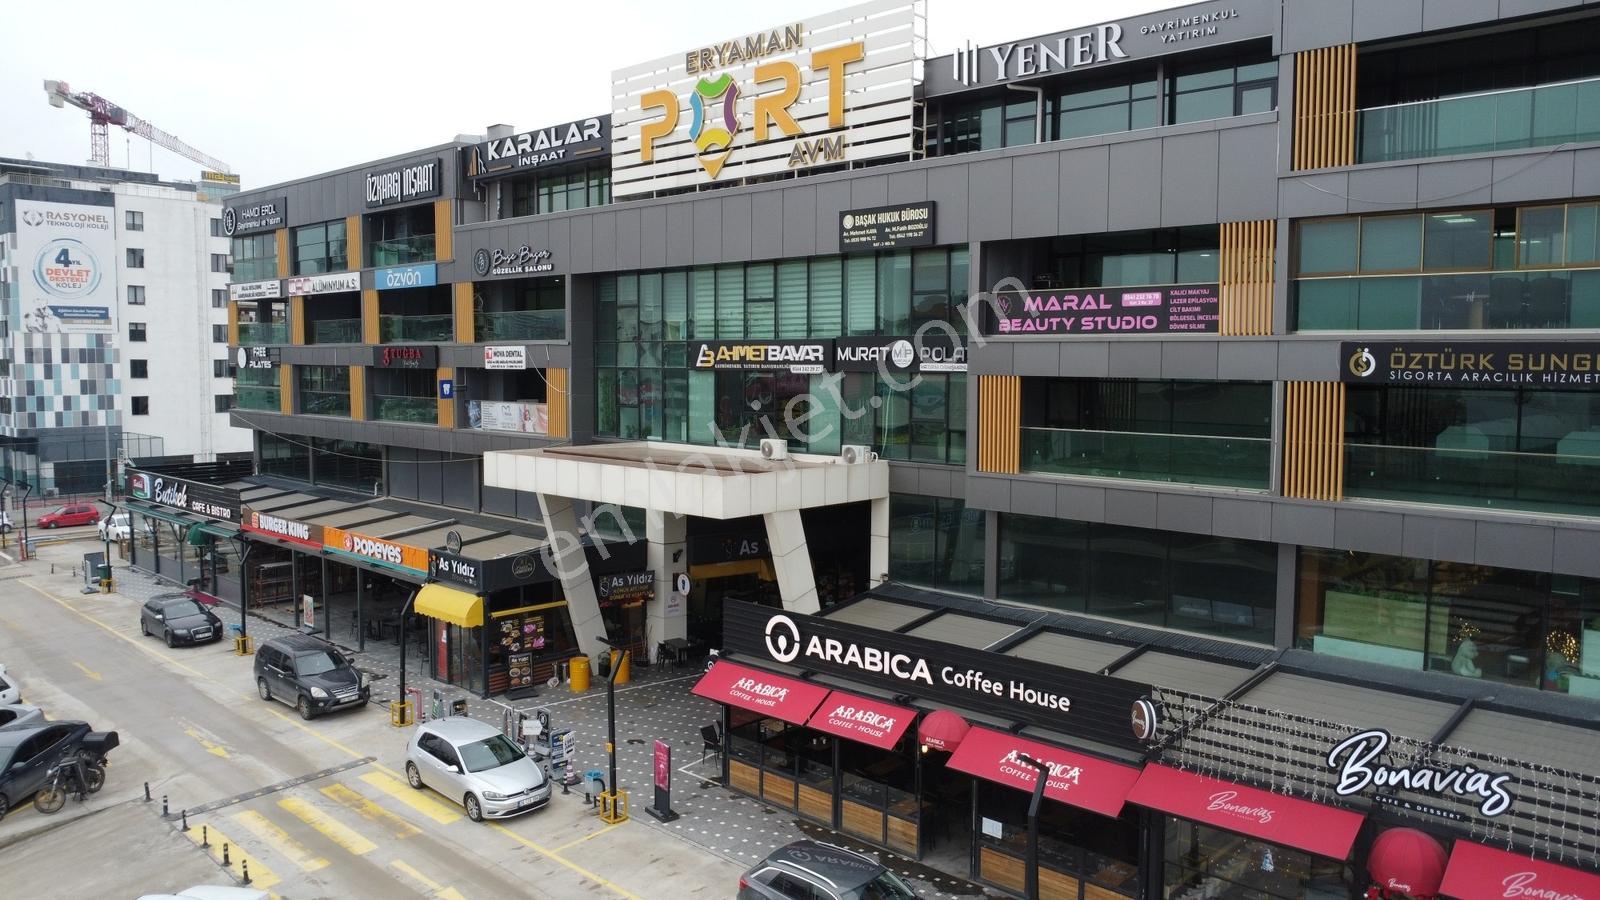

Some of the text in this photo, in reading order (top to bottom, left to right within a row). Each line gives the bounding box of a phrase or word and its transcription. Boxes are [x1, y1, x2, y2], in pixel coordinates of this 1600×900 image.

[1140, 8, 1239, 35] GAYRİMENKUL
[1160, 26, 1218, 44] YATIRIM
[685, 22, 803, 75] ERYAMAN
[988, 23, 1129, 81] YENER
[487, 117, 601, 161] KARALAR
[518, 149, 566, 168] İNŞAAT
[788, 133, 846, 168] AVM
[46, 211, 109, 224] RASYONEL
[46, 220, 109, 231] TEKNOLOJİ KOLEJİ
[855, 207, 928, 227] BAŞAK HUKUK BÜROSU
[55, 248, 72, 268] 4
[46, 268, 91, 278] DEVLET
[492, 263, 552, 275] GÜZELLİK SALONU
[1023, 293, 1113, 312] MARAL
[998, 315, 1158, 332] BEAUTY STUDIO
[252, 346, 267, 358] FREE
[505, 350, 524, 358] DENTAL
[837, 346, 890, 361] MURAT
[1389, 347, 1600, 372] ÖZTÜRK SUNG
[1389, 370, 1600, 383] SİGORTA ARACILIK HİZMET
[191, 501, 231, 519] CAFE & BISTRO
[259, 514, 288, 535] BURGER
[287, 521, 309, 541] KING
[739, 540, 758, 555] As
[439, 557, 475, 577] As Yıldız
[611, 574, 653, 588] As Yıldız
[804, 636, 1071, 712] ARABICA Coffee House
[729, 689, 777, 707] COFFEE HOUSE
[731, 677, 790, 702] ARABICA
[828, 705, 896, 732] ARABICA
[828, 718, 884, 738] COFFEE HOUSE
[1000, 765, 1071, 791] COFFEE OUSE
[1328, 730, 1511, 816] Bonavias
[1207, 790, 1276, 823] Bonavias
[1375, 795, 1399, 806] CAFE
[1416, 805, 1462, 820] DESSERT
